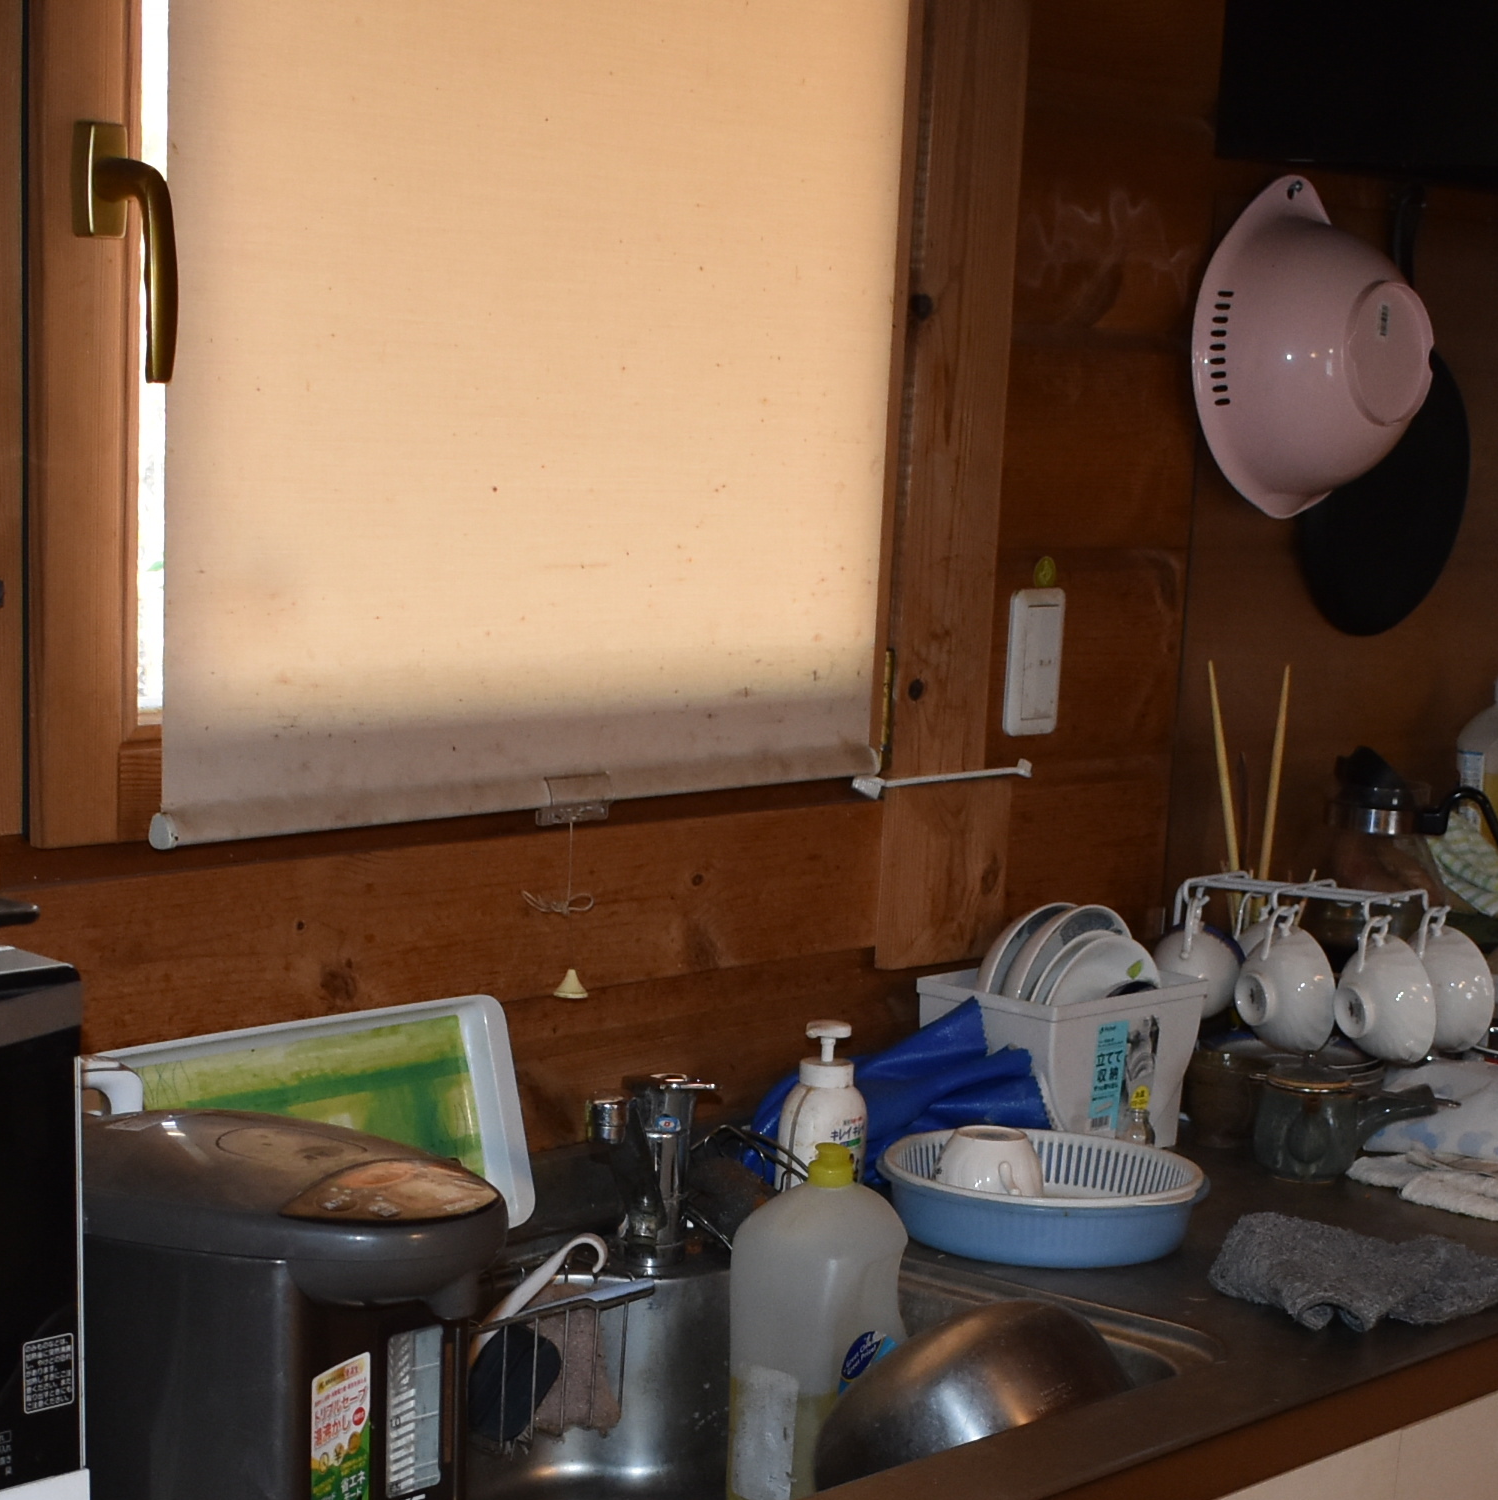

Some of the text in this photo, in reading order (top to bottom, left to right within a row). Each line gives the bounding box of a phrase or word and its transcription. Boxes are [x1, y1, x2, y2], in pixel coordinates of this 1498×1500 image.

[1096, 1050, 1123, 1067] 立てて
[341, 1470, 366, 1493] 省エネ
